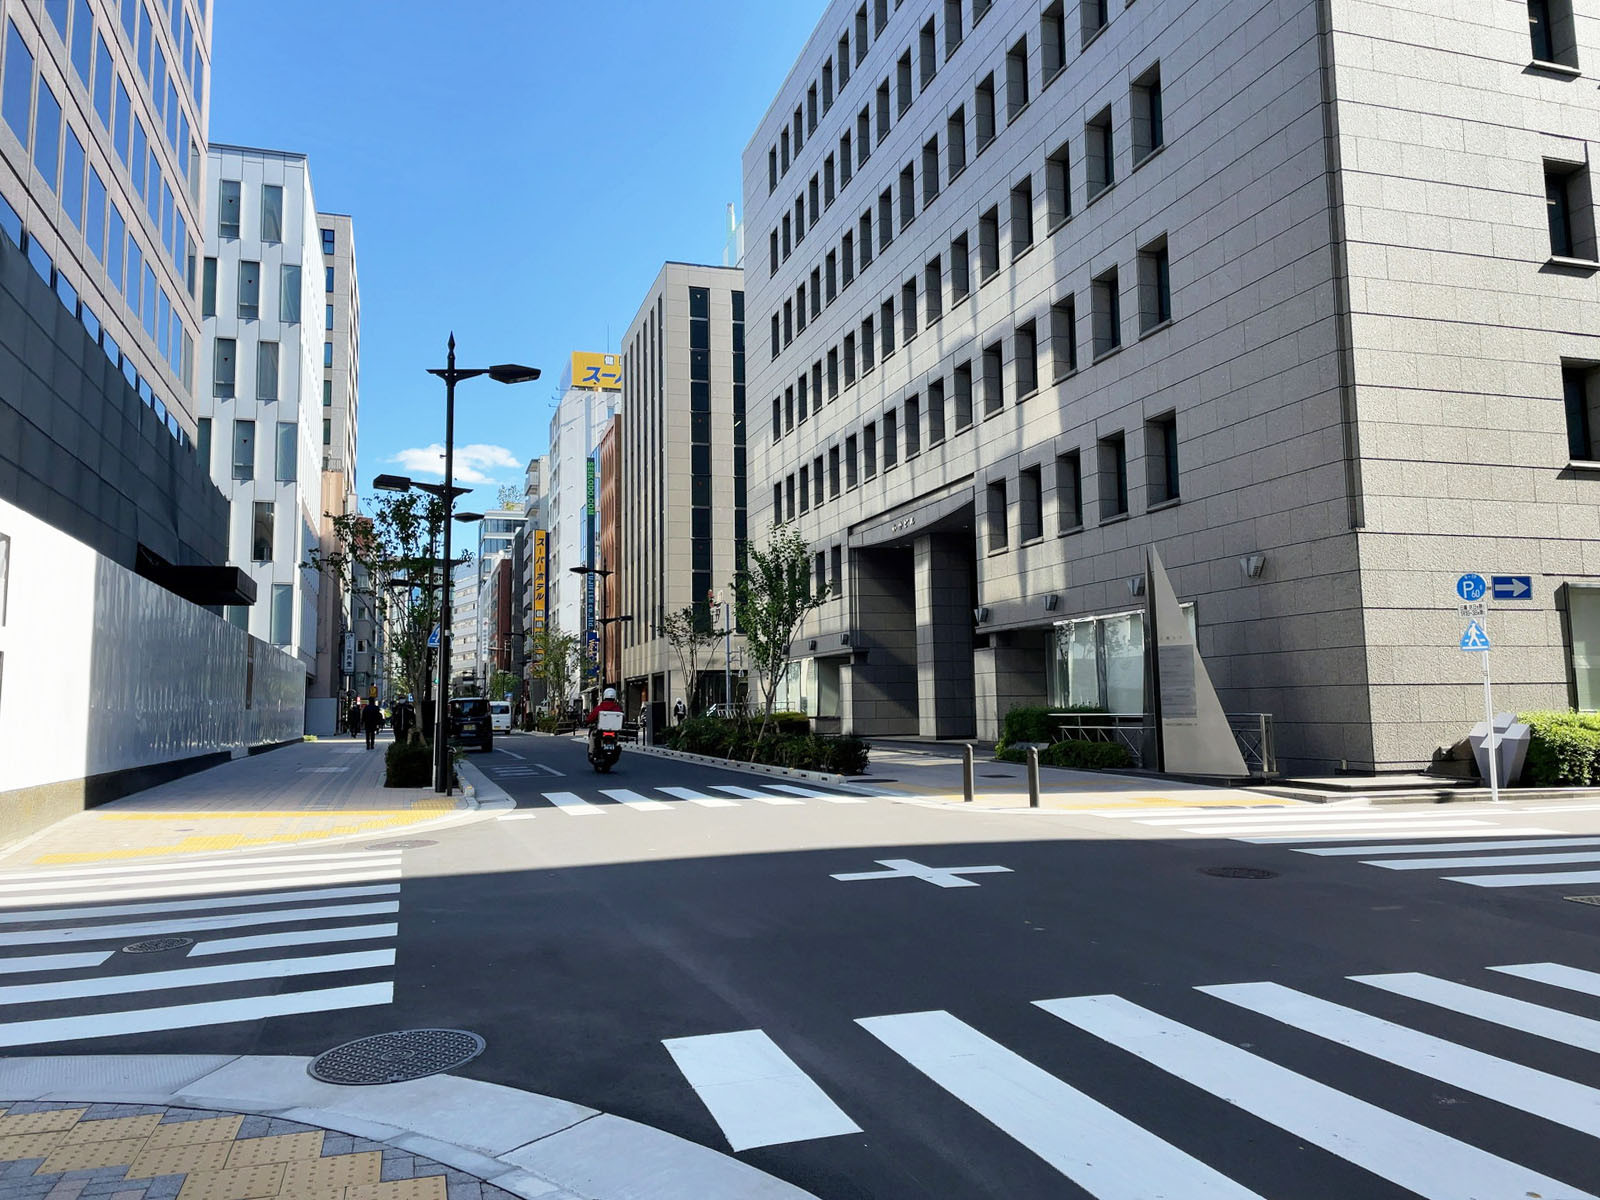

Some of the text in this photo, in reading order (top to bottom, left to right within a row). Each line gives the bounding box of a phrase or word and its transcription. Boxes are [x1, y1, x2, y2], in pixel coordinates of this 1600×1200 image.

[535, 537, 545, 601] スーパーホテル
[1463, 581, 1474, 598] P
